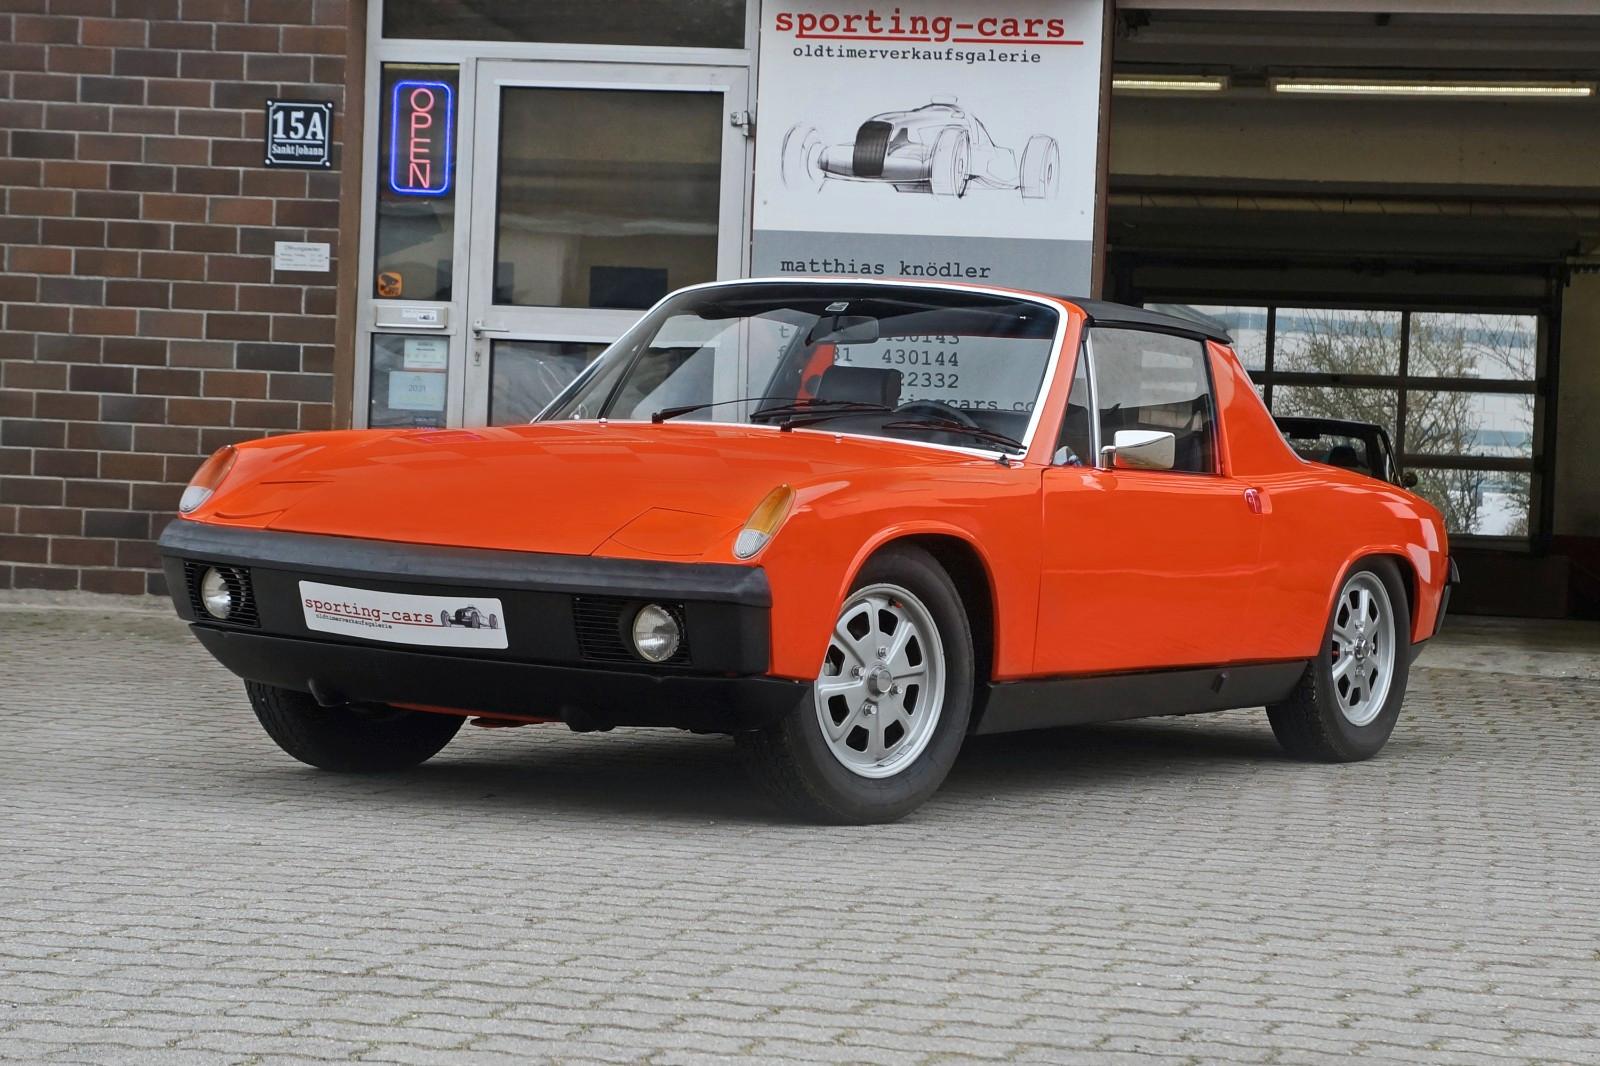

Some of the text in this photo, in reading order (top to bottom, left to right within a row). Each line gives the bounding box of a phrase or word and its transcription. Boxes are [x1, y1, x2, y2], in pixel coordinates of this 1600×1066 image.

[776, 8, 1065, 41] sporting-cars
[793, 45, 1041, 64] oldtimerverkaufsgalerie
[273, 110, 324, 140] 15A
[272, 144, 324, 156] Sankt Johann
[409, 88, 434, 188] OPEN
[780, 258, 991, 278] matthias knödler
[882, 349, 959, 367] 430144
[305, 597, 434, 625] sporting-cars
